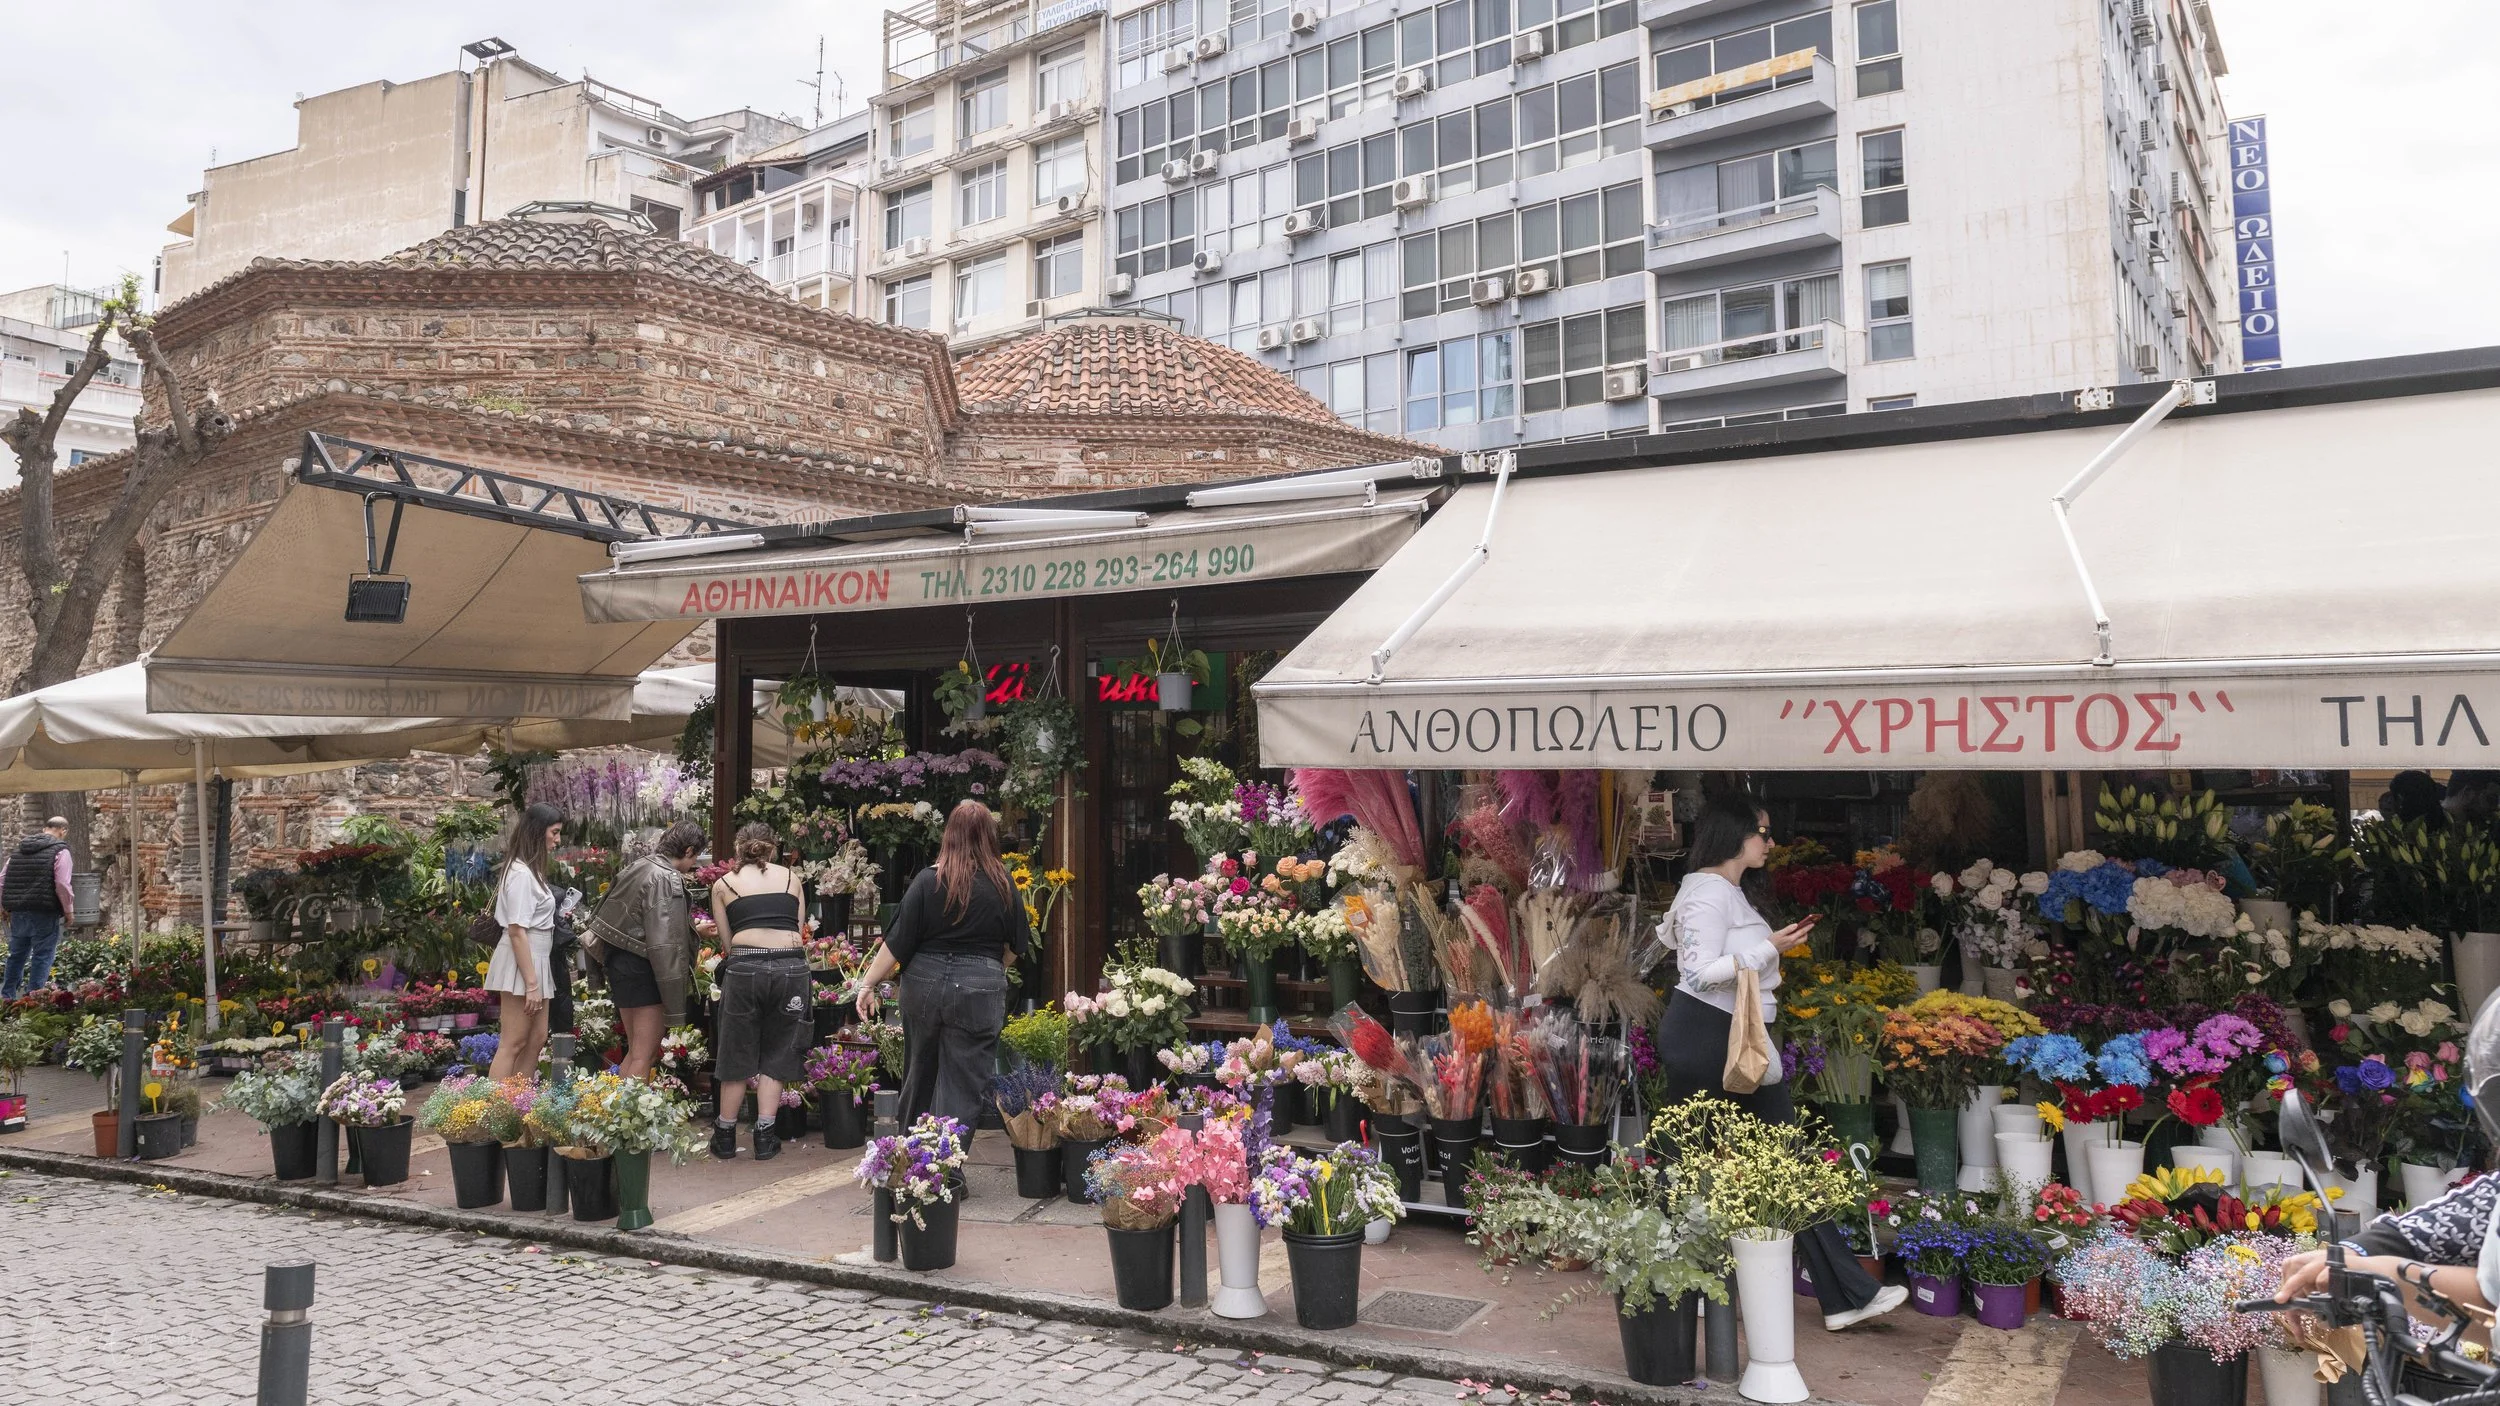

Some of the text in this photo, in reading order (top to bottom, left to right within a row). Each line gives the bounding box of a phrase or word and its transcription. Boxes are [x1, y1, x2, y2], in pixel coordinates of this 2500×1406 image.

[1046, 0, 1104, 29] ΠΥΘΑΓΟΡΑΣ
[2233, 120, 2265, 190] ΝΕΟ
[2238, 217, 2275, 335] ΩΔΕΙΟ
[679, 543, 1255, 614] ΑΘΗΝΑΪΚΟΝ ΤΗΛ. 2310 228 293-264 990
[1349, 703, 1728, 754] ΑΝΘΟΠΩΛΕΙΟ
[2320, 694, 2490, 747] ΤΗΛ
